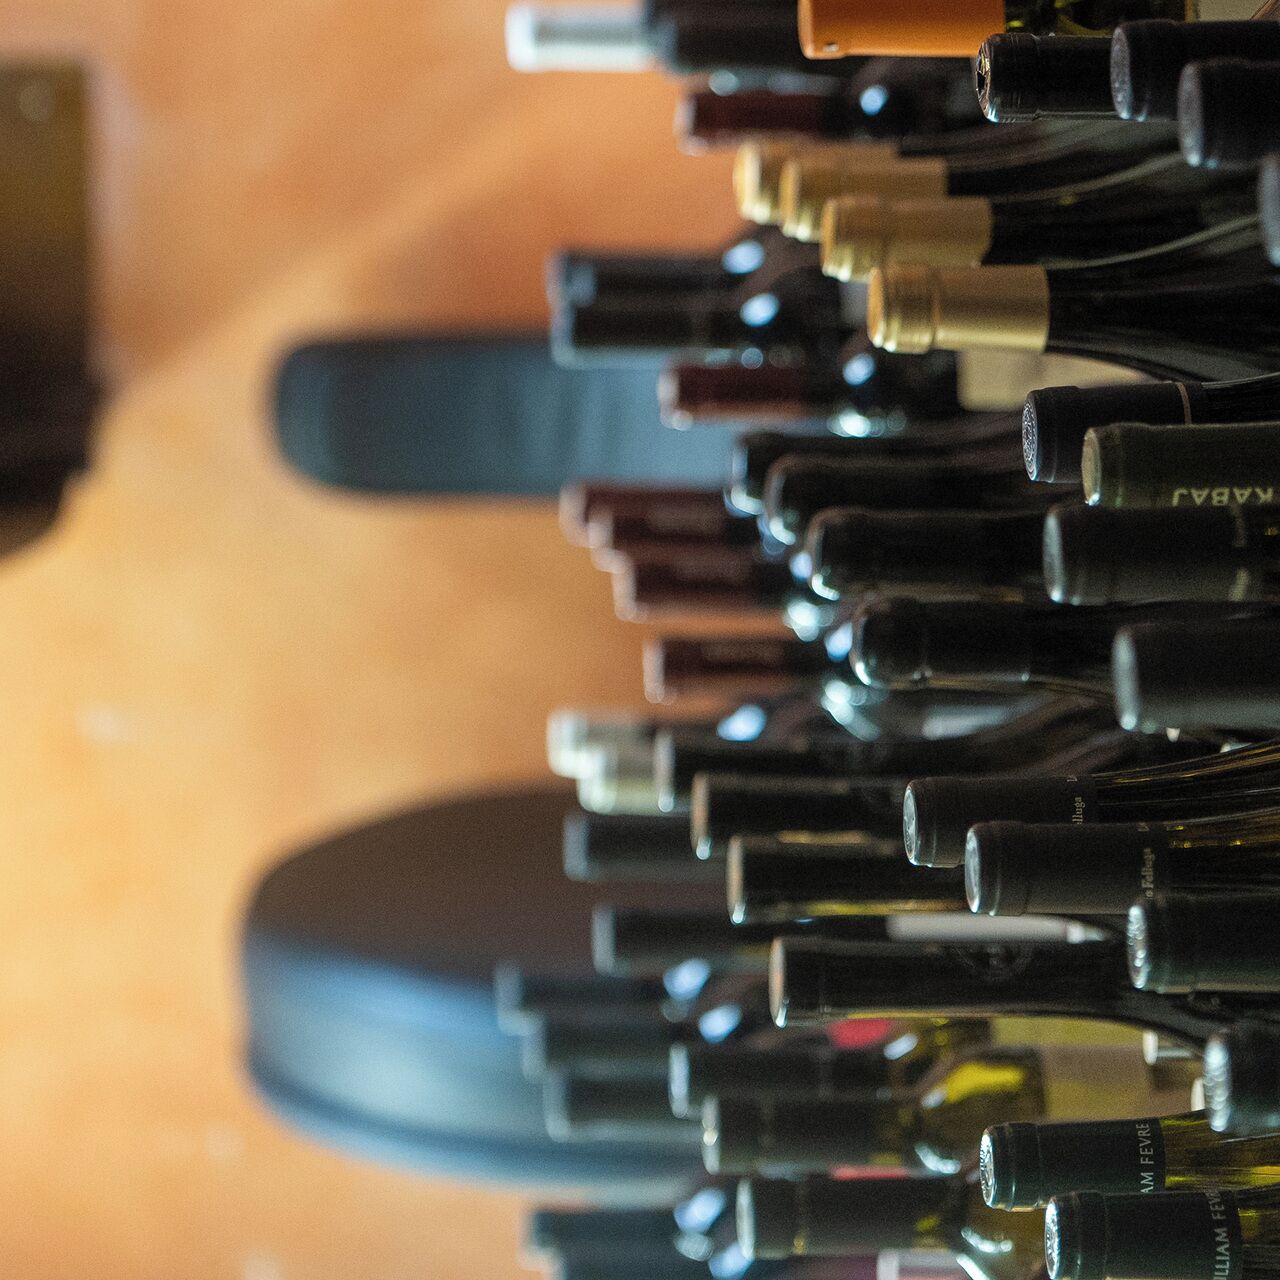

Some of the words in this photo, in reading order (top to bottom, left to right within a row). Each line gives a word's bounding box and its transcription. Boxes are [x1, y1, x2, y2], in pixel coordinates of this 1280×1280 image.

[1171, 486, 1275, 508] KABAJ
[1141, 846, 1156, 889] Felluga
[1135, 1123, 1155, 1166] FEVRE
[1212, 1227, 1231, 1280] ILLIAM
